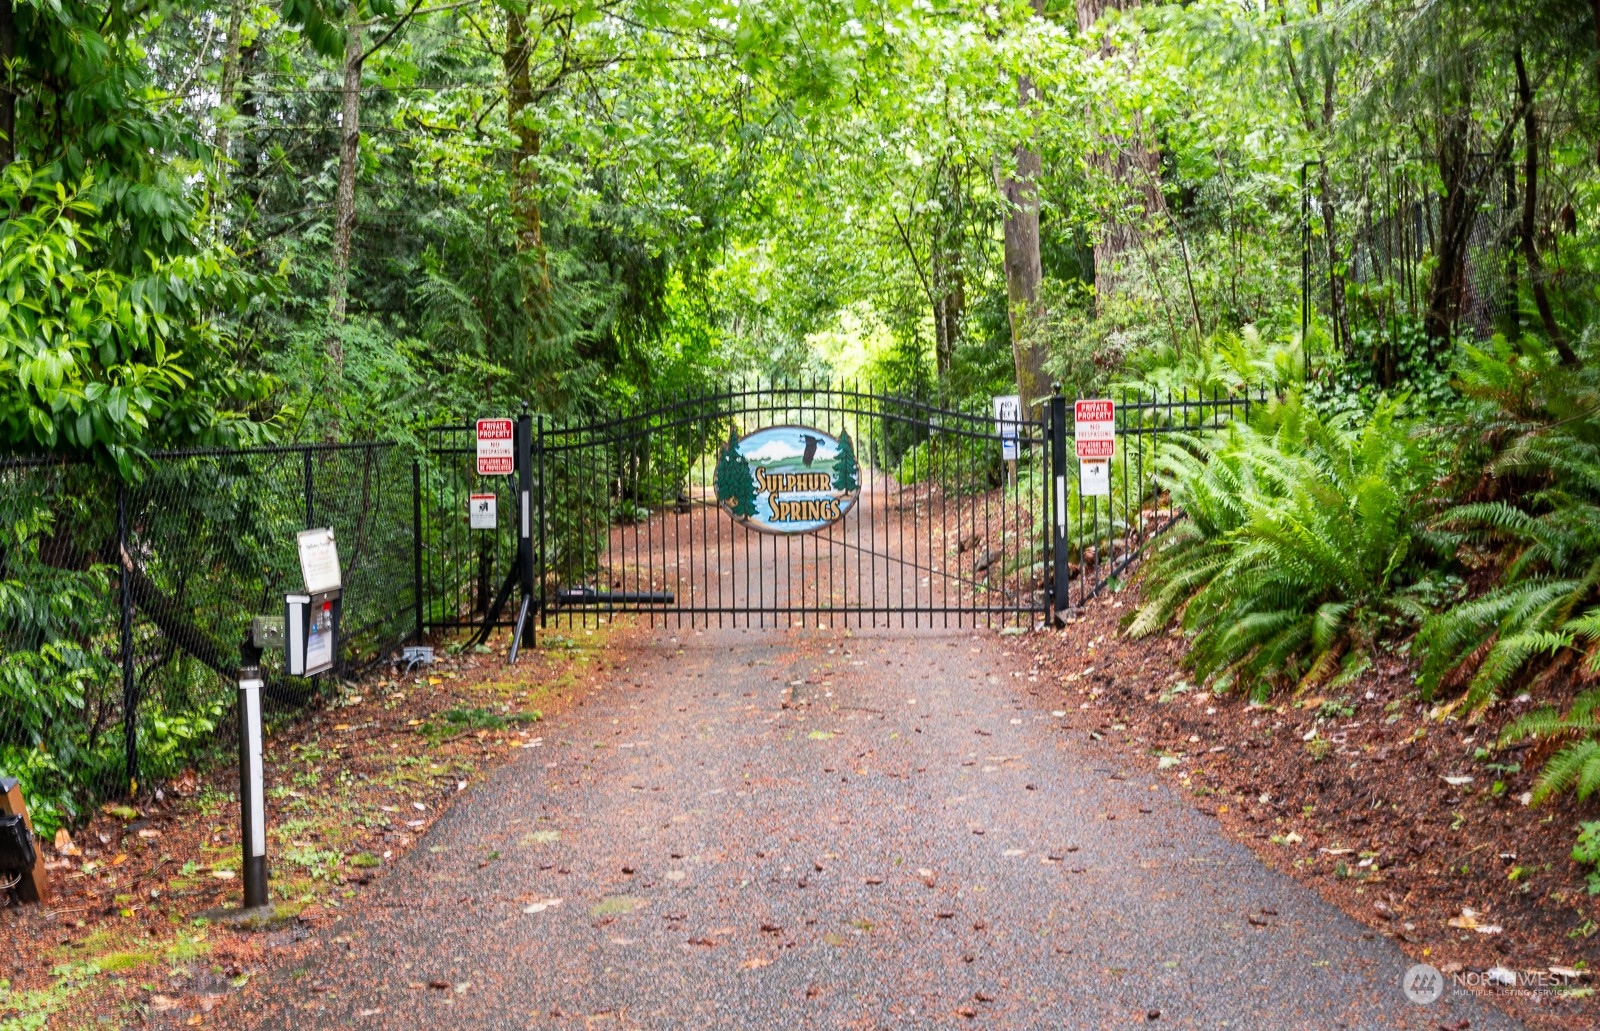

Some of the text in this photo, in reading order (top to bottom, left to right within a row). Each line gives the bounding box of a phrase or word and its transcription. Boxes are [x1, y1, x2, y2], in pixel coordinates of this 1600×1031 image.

[1081, 403, 1108, 411] PRIVATE
[1078, 411, 1111, 420] PROPERTY
[482, 422, 507, 430] PRIVATE
[480, 430, 510, 438] PROPERTY
[755, 466, 832, 493] SULPHUR
[768, 491, 841, 522] SPRINGS
